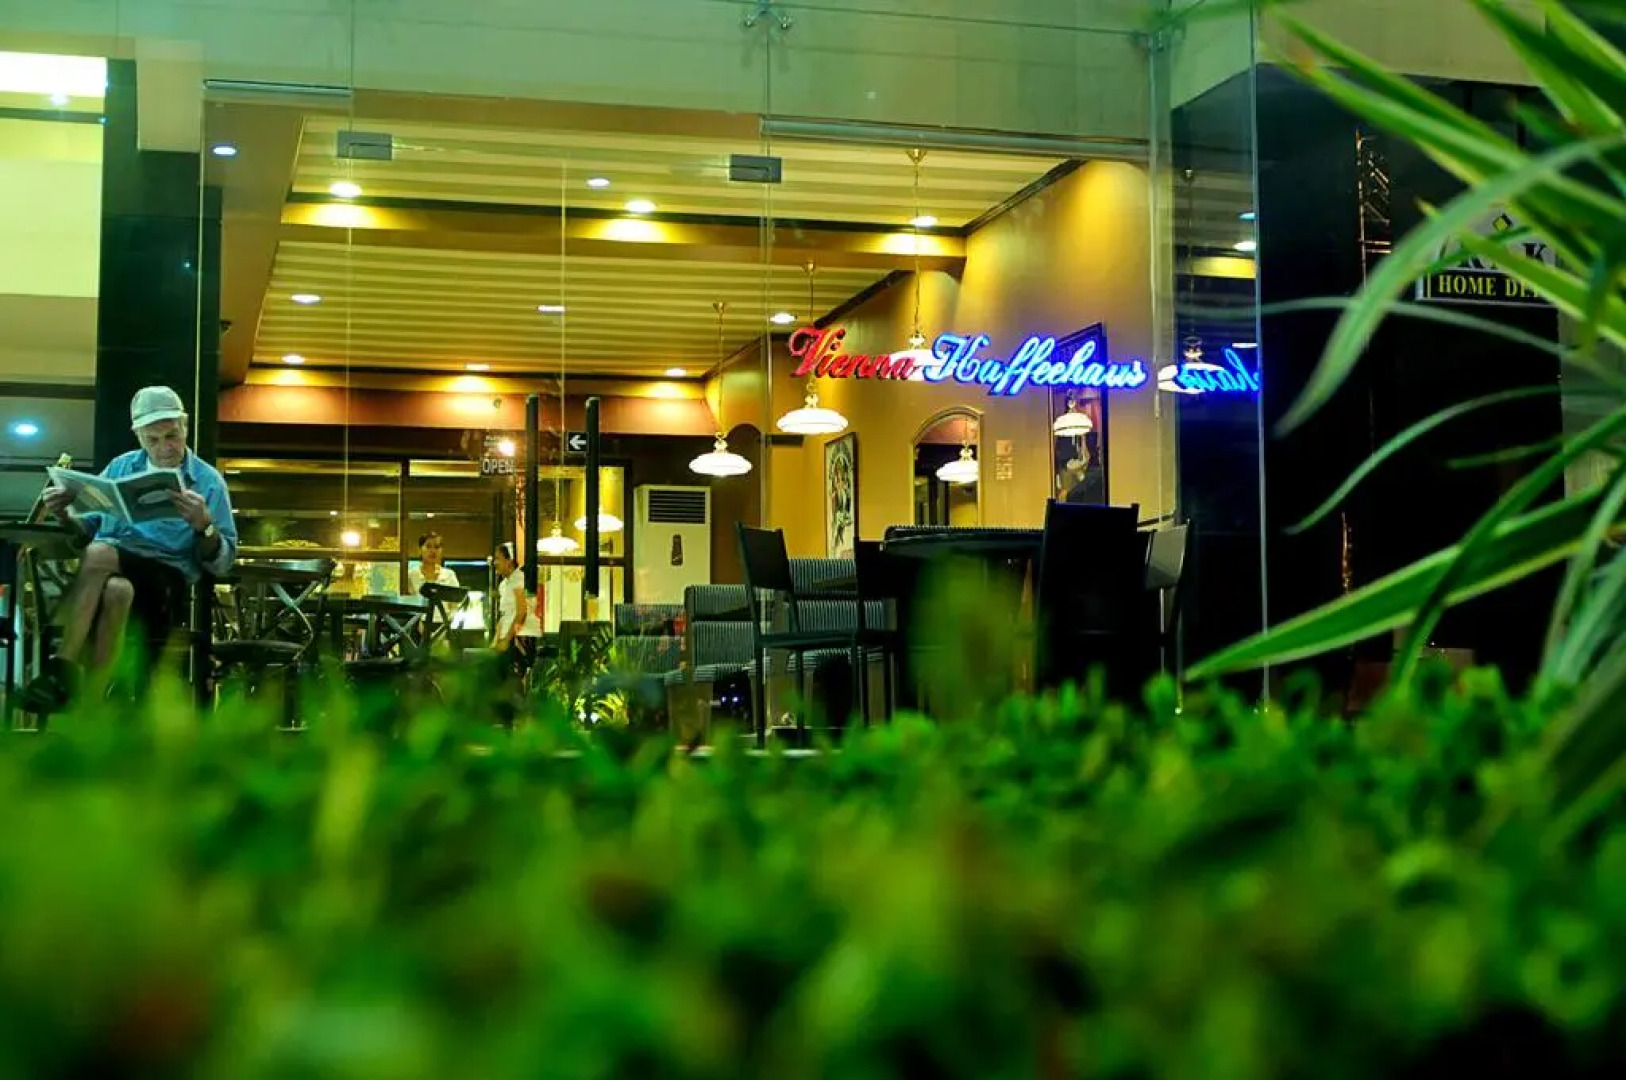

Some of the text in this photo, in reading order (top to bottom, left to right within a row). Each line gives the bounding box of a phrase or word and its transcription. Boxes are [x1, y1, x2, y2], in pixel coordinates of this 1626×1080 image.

[1438, 274, 1497, 296] HOME
[788, 326, 1149, 396] Vienna Kaffeehaus
[482, 458, 514, 475] OPEN
